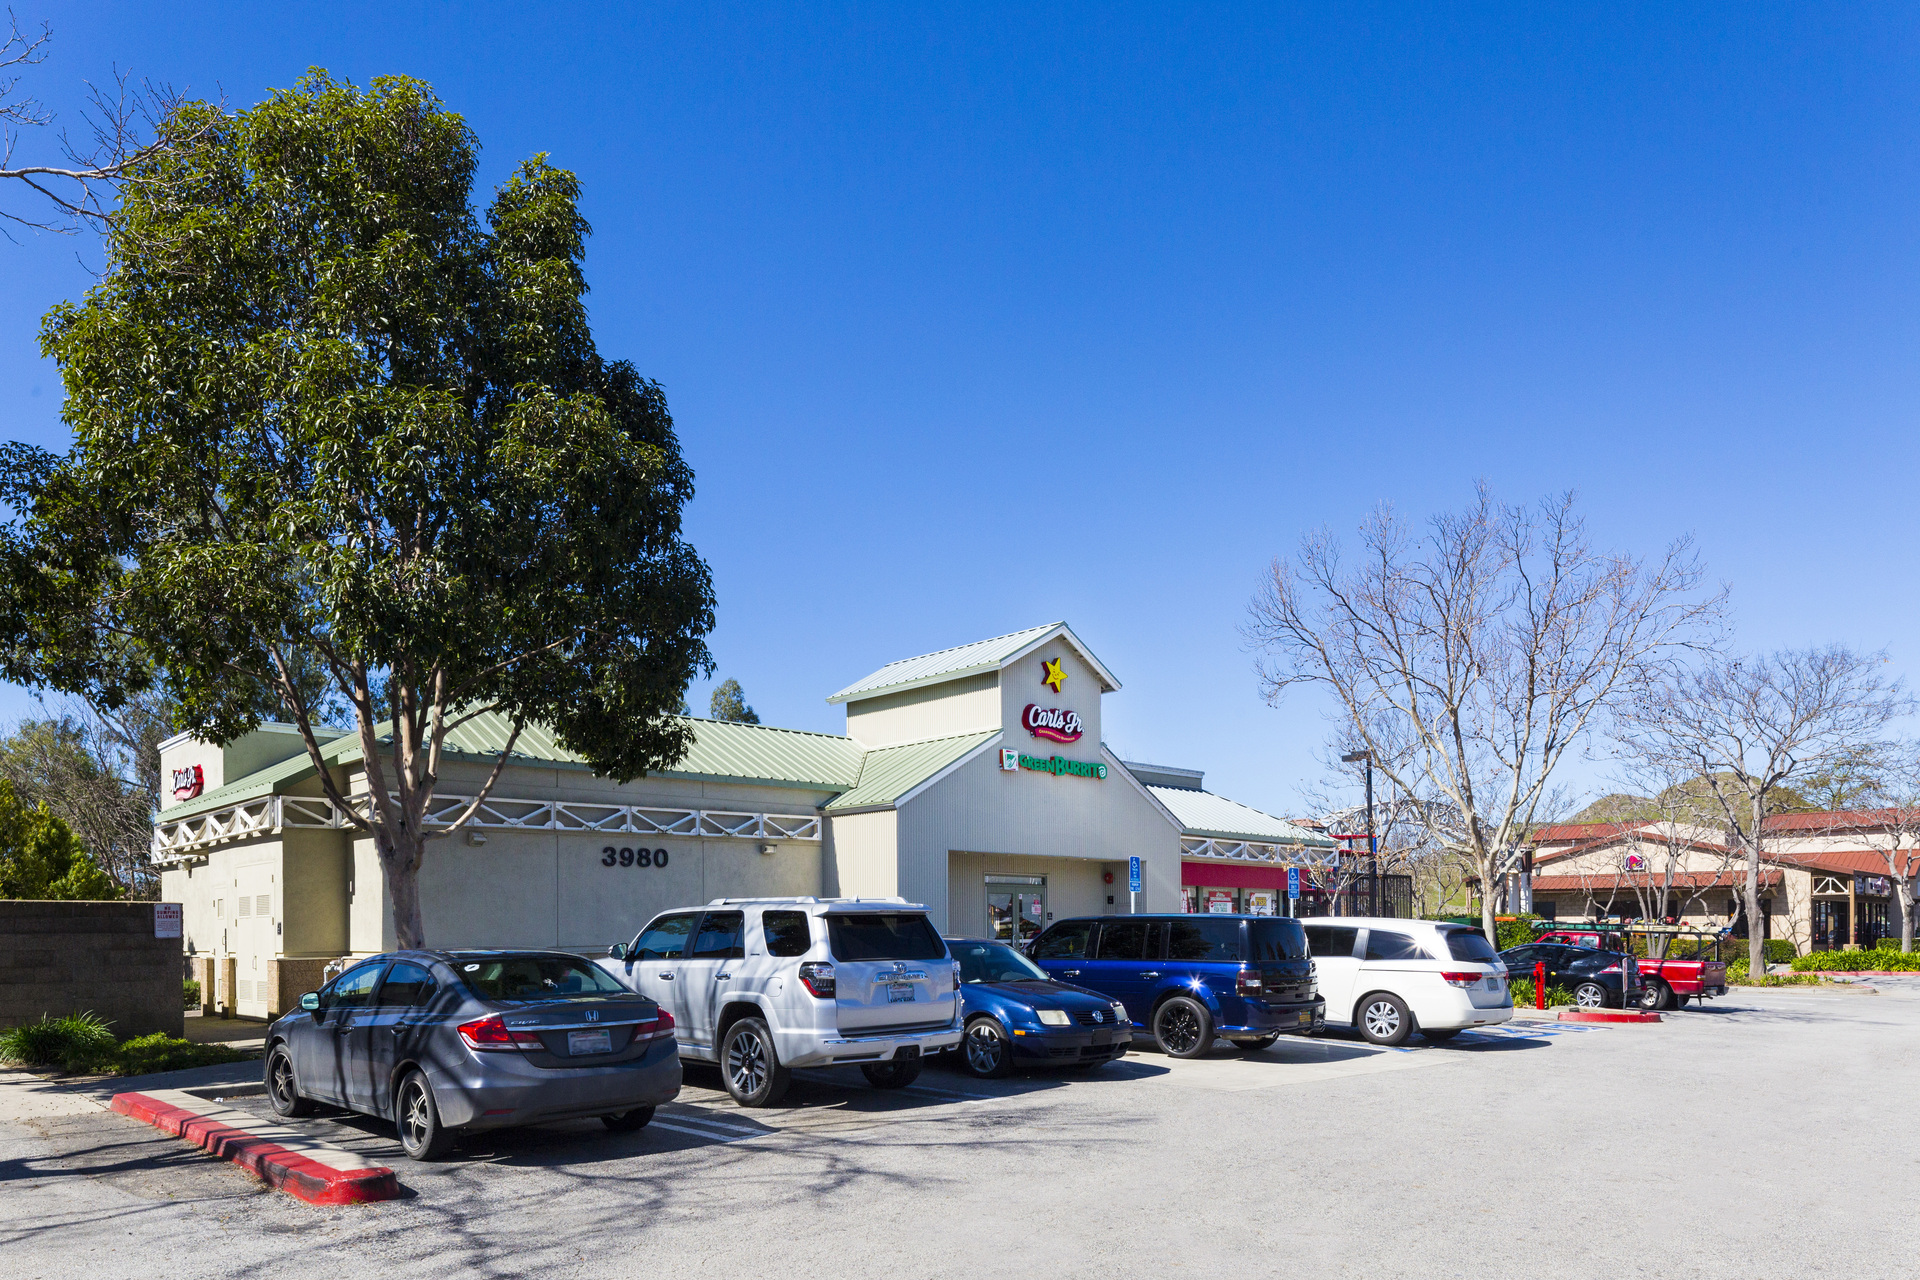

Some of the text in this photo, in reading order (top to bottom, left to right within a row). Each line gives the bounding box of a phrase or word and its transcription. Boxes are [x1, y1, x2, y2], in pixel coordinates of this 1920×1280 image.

[1029, 706, 1065, 729] Carl's
[1019, 755, 1107, 779] GREEN BURRITO
[601, 846, 669, 868] 3980
